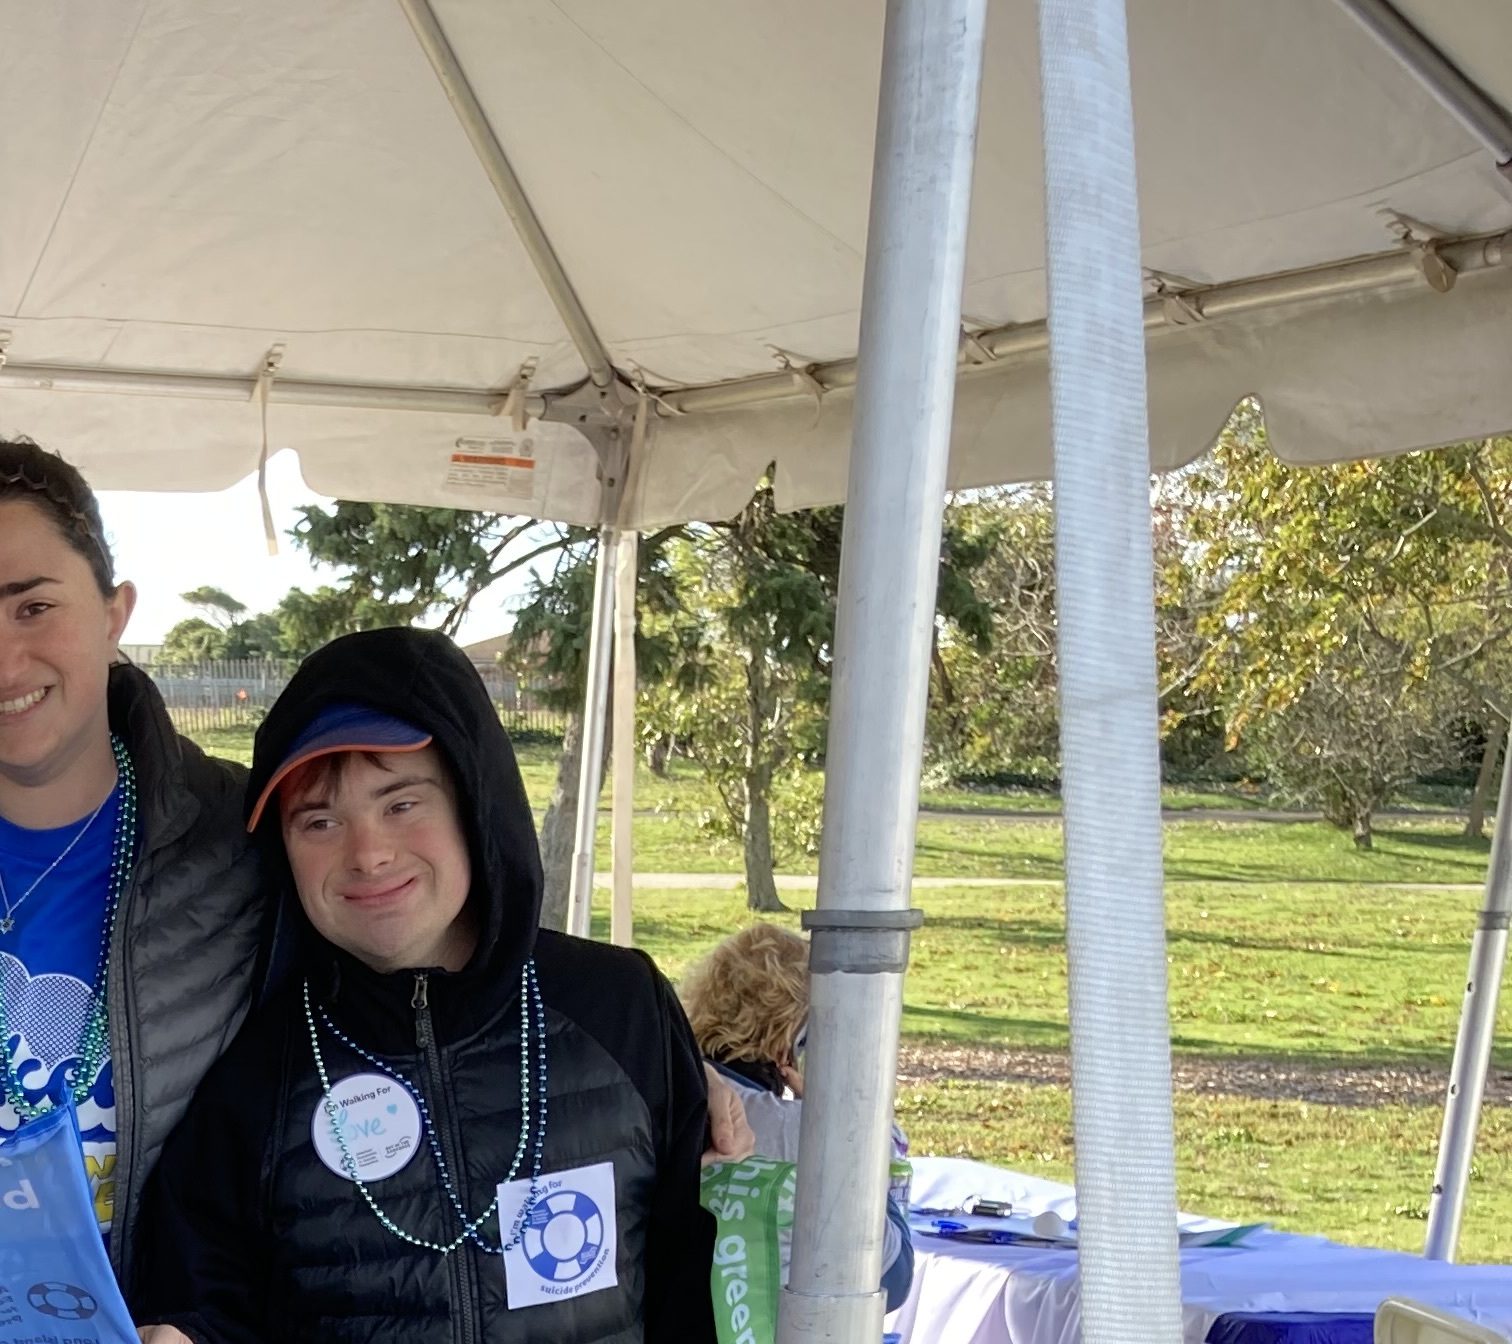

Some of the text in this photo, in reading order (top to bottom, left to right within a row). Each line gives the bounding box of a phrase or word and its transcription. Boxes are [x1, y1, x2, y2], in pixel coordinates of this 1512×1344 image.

[338, 1091, 376, 1109] Walking
[375, 1085, 392, 1097] For
[548, 1180, 563, 1191] for
[540, 1283, 574, 1295] suicide
[574, 1247, 610, 1293] prevention
